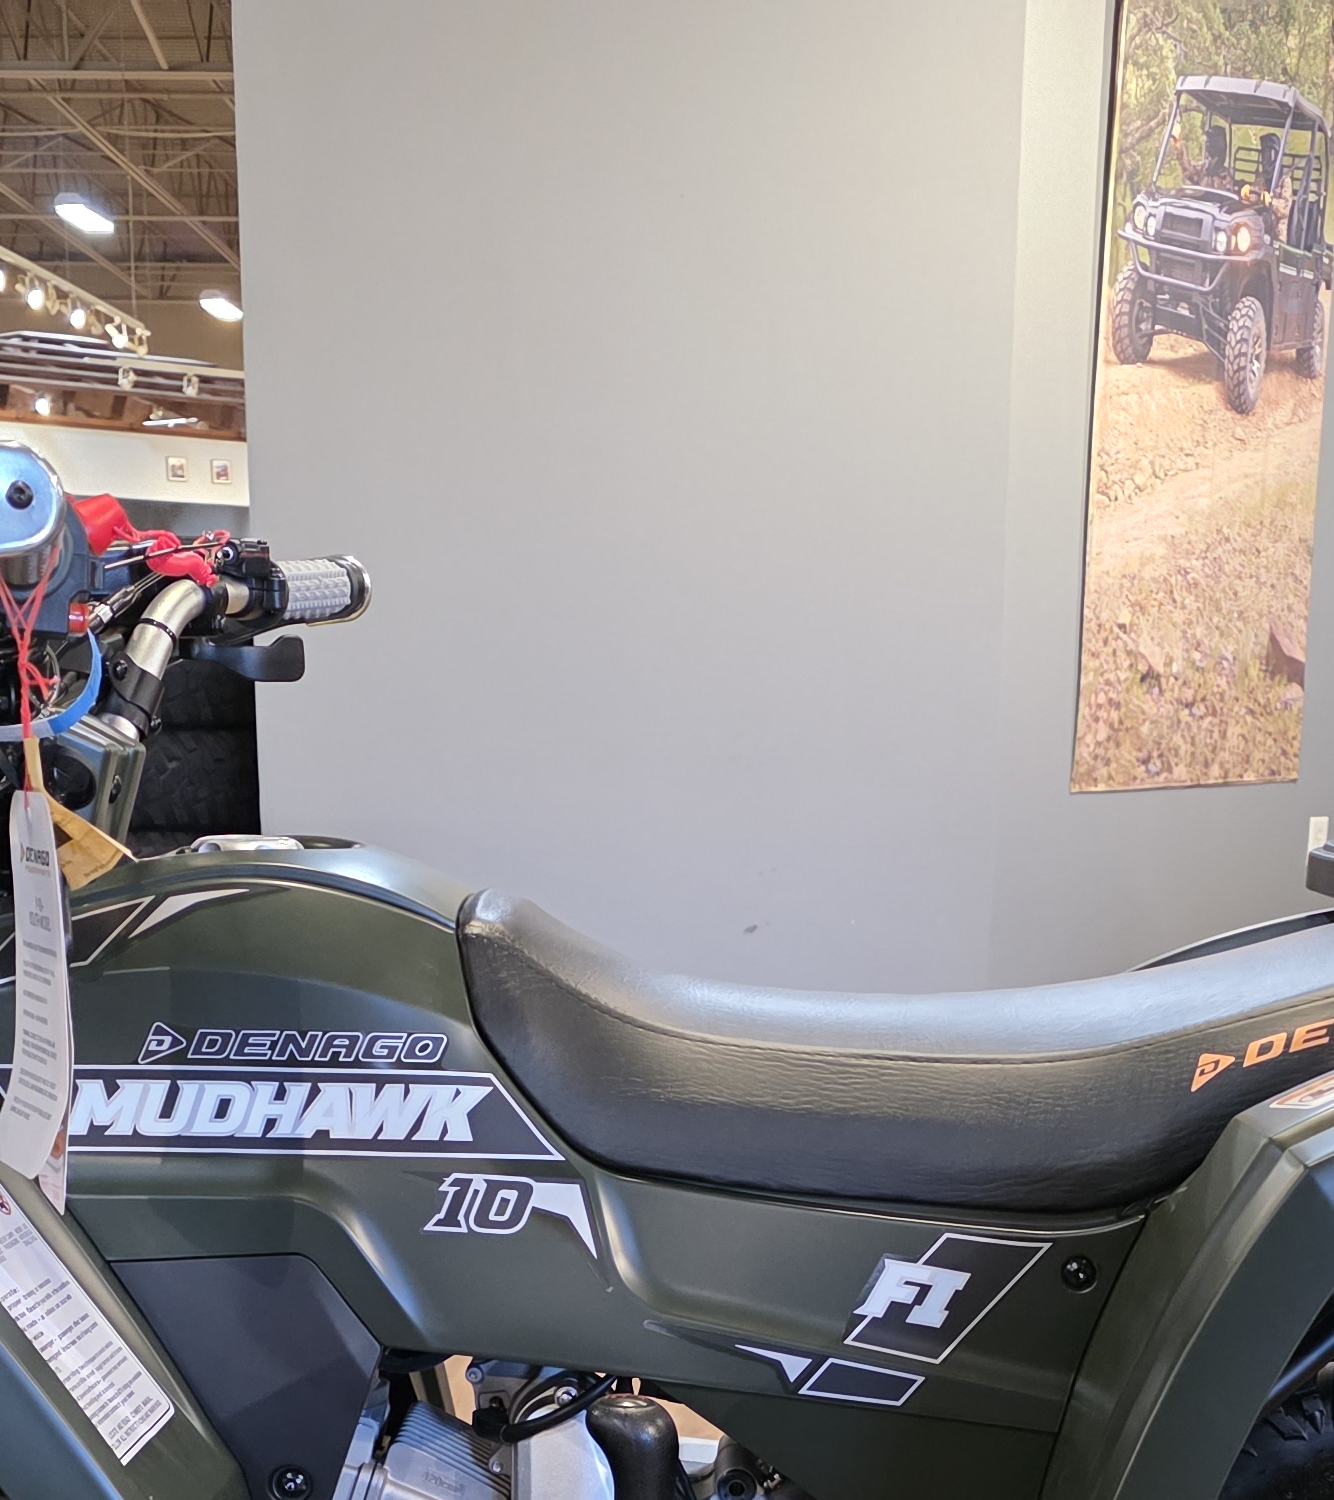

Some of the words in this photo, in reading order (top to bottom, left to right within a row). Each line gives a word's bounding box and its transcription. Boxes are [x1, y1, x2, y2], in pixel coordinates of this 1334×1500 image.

[186, 1029, 447, 1063] DENAGO
[68, 1079, 494, 1142] MUDHAWK
[422, 1172, 535, 1235] 10
[853, 1258, 971, 1328] FI
